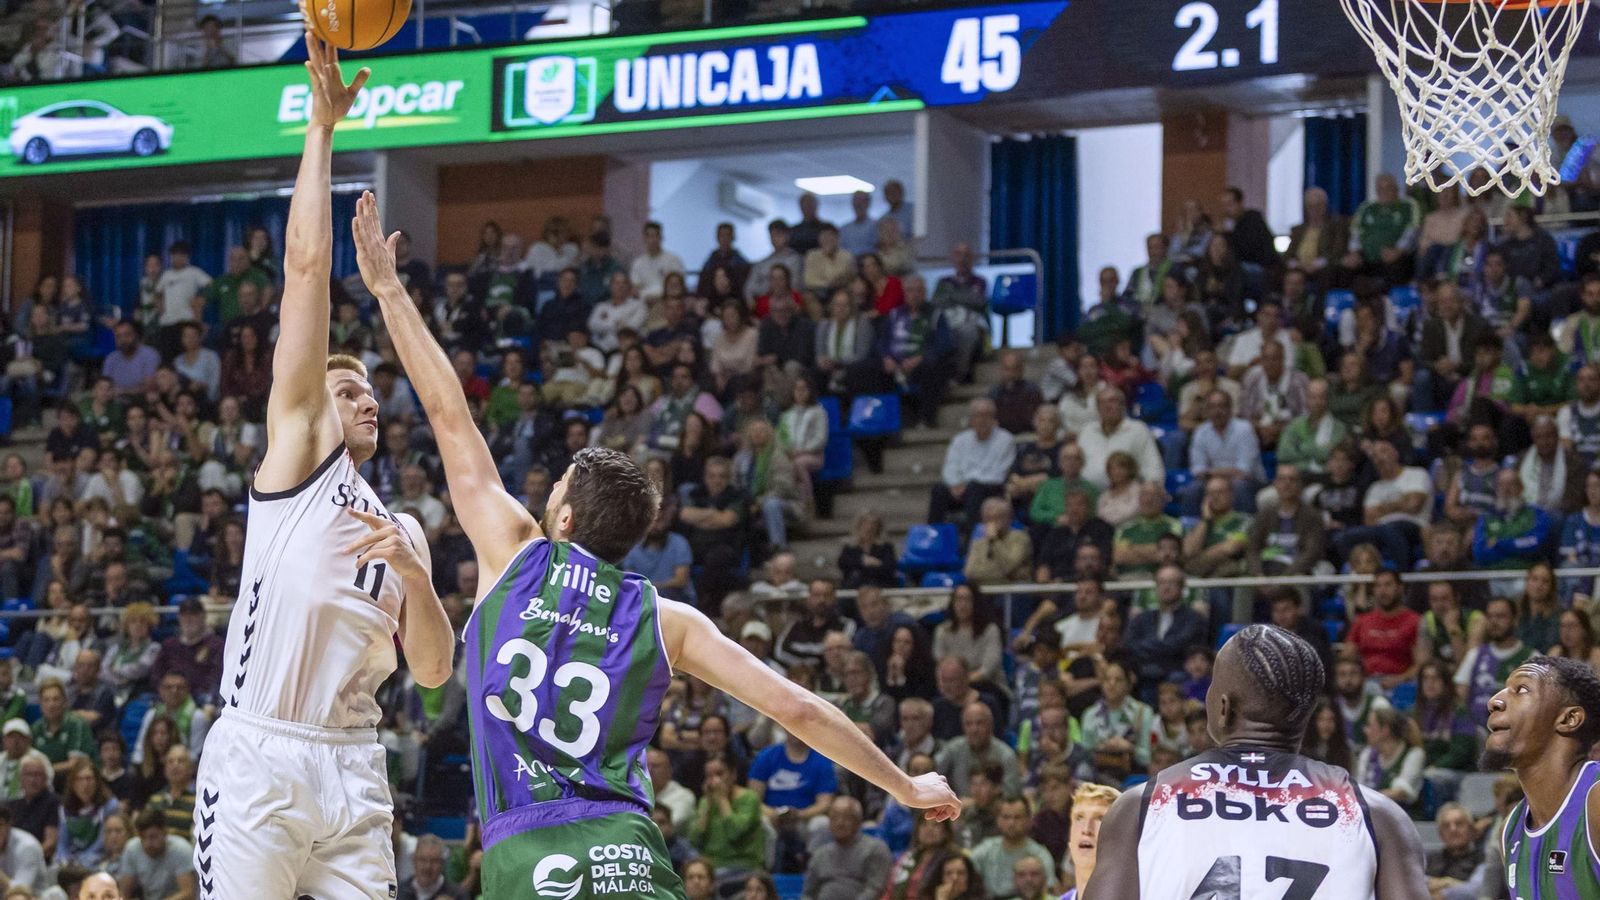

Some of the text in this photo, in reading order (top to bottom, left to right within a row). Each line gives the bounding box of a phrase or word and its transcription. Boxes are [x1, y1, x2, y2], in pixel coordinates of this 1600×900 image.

[1172, 0, 1280, 71] 2.1
[613, 14, 1021, 113] UNICAJA 45
[277, 80, 465, 129] Eopcar
[485, 638, 610, 758] 33
[1190, 763, 1313, 788] SYLLA
[588, 844, 654, 863] COSTA
[591, 862, 652, 879] DEL SOL
[593, 877, 655, 894] MÁLAGA
